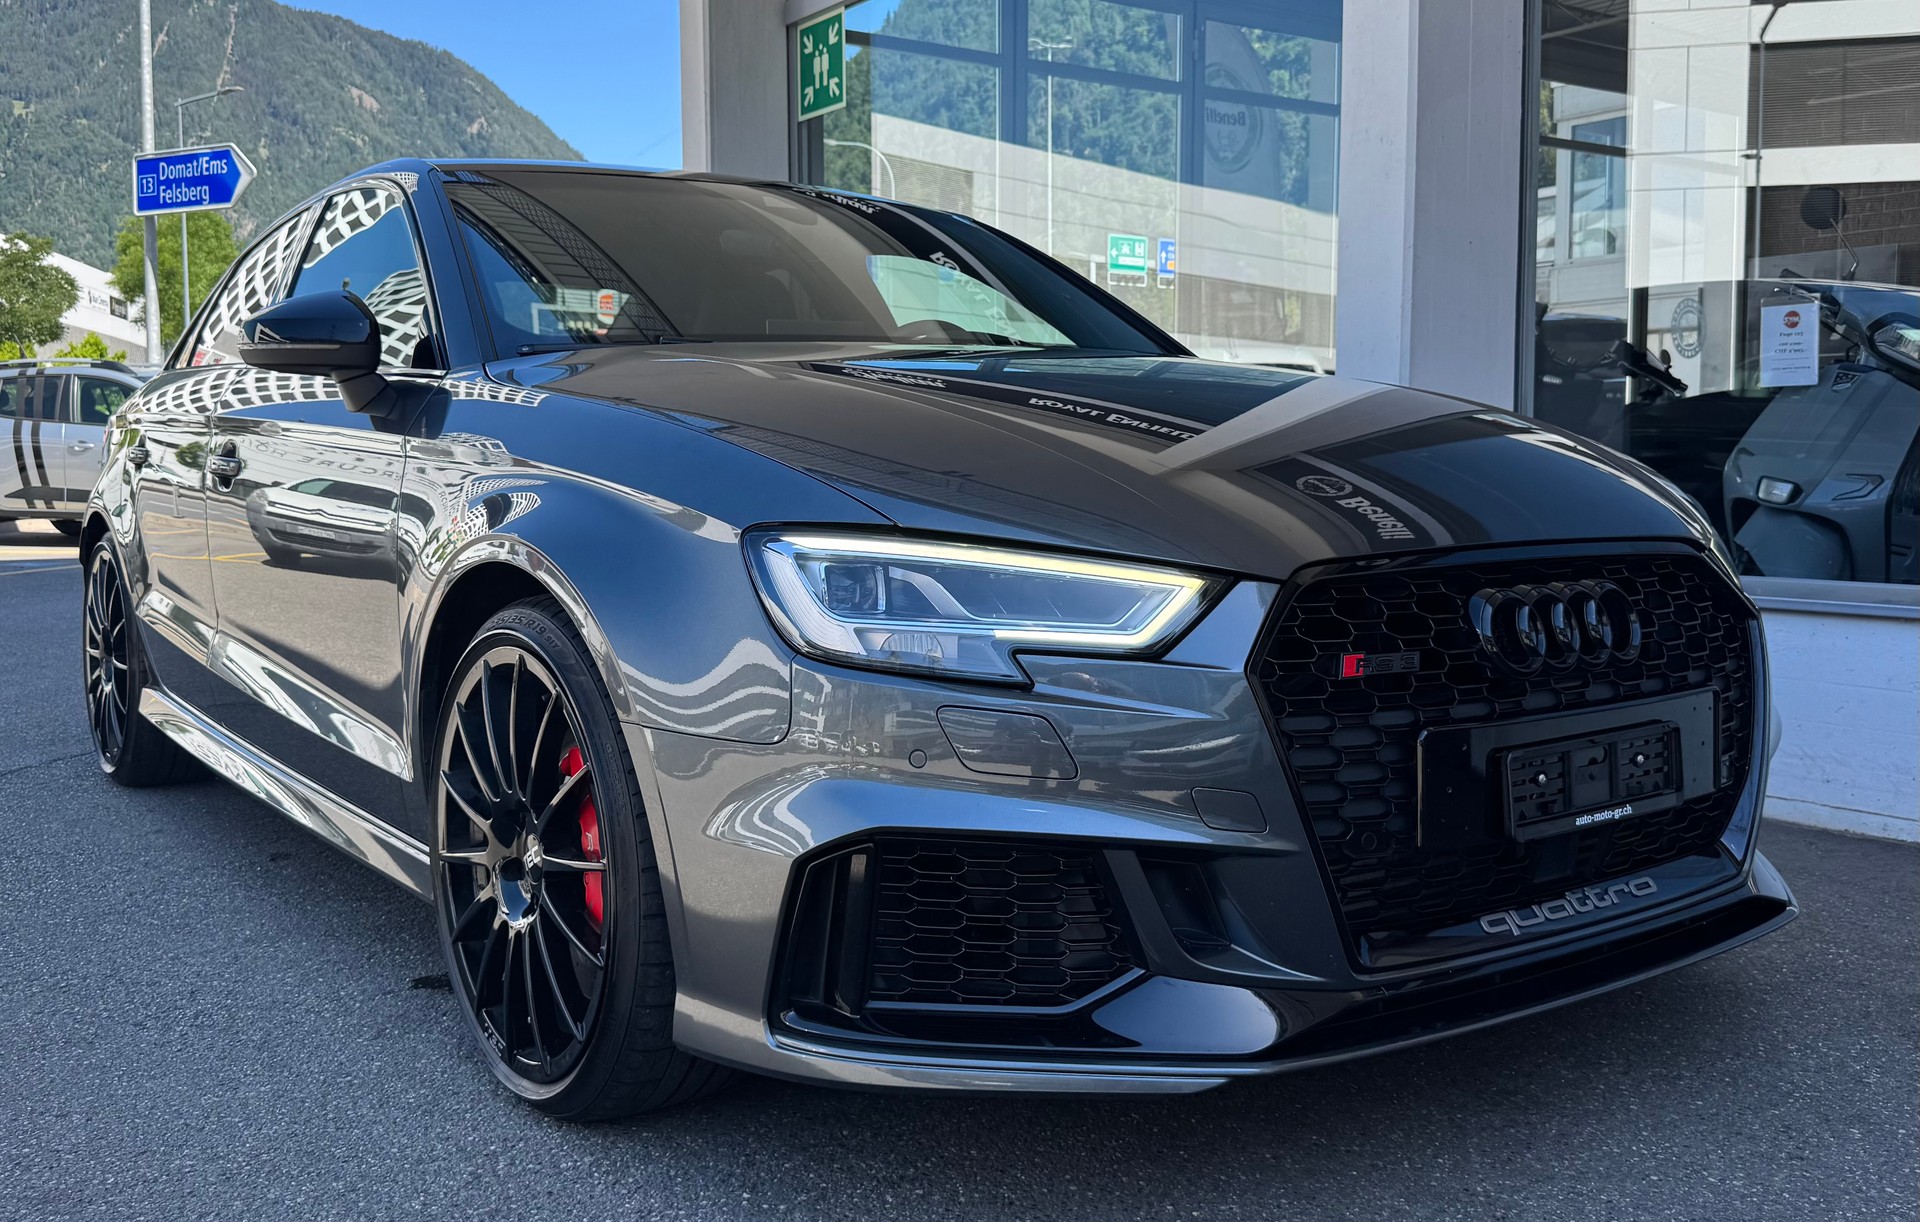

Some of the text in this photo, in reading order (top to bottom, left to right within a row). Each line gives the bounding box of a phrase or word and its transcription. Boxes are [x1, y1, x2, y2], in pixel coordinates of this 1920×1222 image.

[159, 156, 228, 181] Domat/Ems
[142, 178, 154, 193] 13
[159, 182, 210, 205] Felsberg
[523, 617, 548, 636] R19
[1575, 803, 1633, 826] auto-moto-gr.ch
[1479, 876, 1658, 937] quattro
